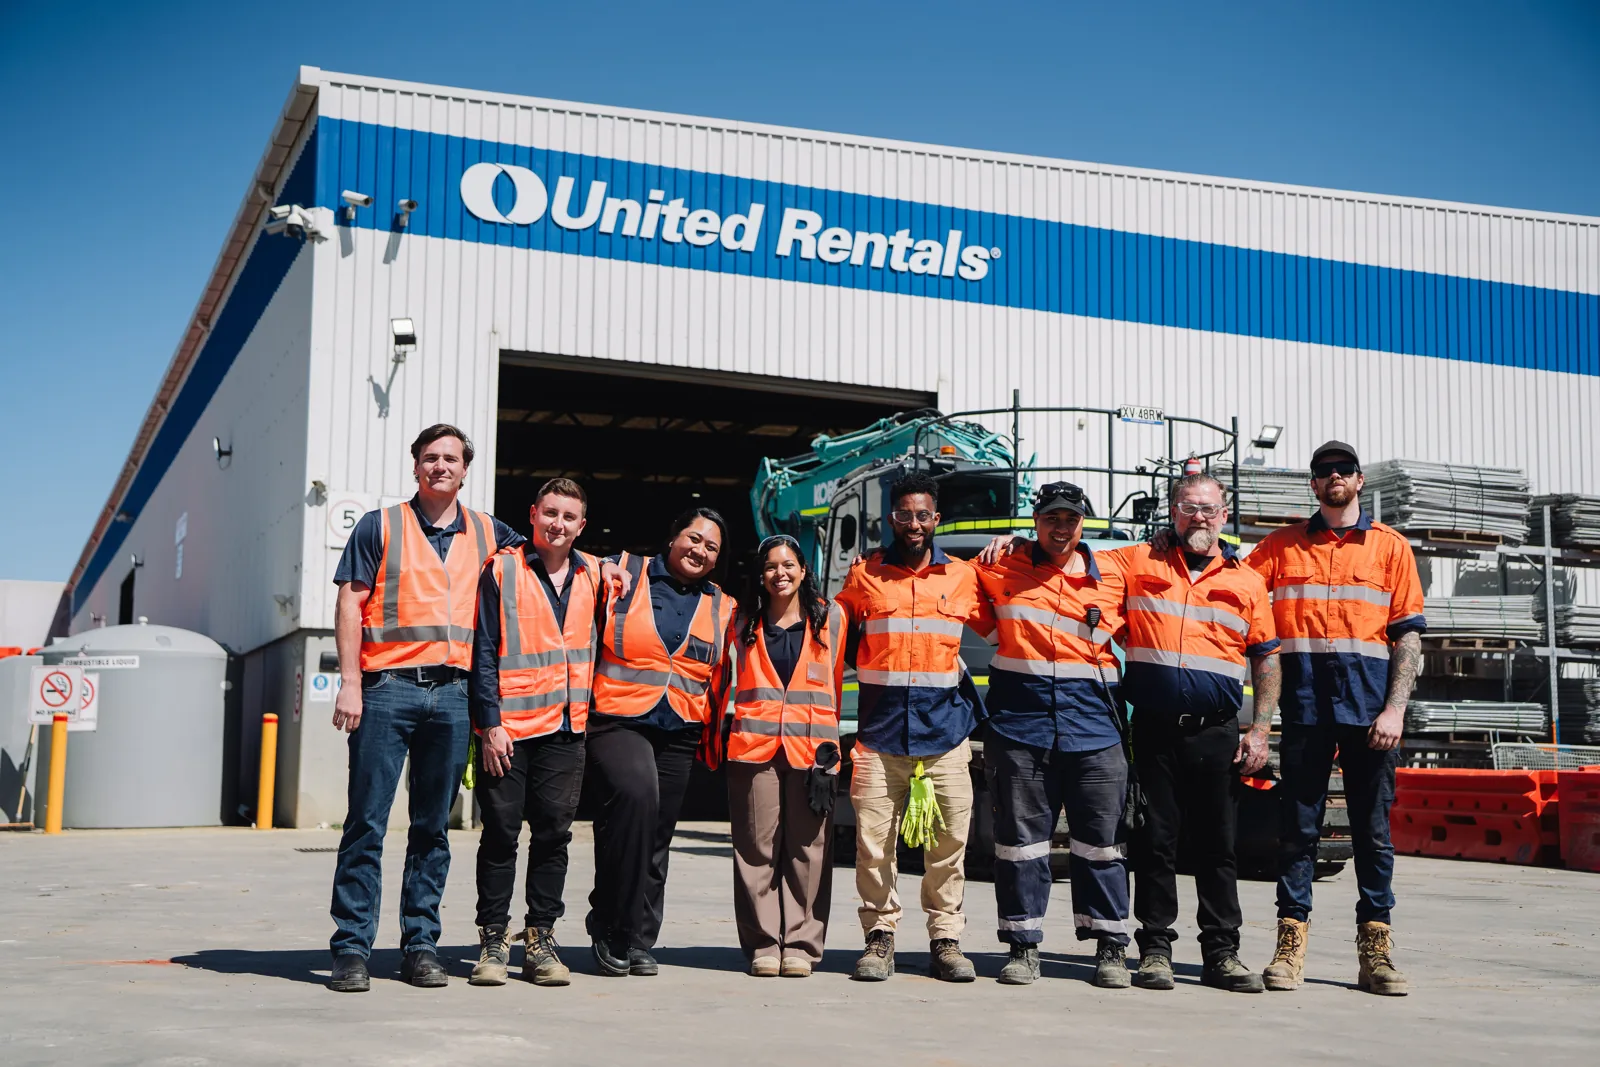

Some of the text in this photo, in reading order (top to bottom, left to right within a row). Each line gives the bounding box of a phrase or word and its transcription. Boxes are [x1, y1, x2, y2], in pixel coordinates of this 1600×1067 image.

[551, 175, 765, 253] United
[343, 510, 356, 529] 5
[65, 658, 137, 667] COMBUSTIBLE LIQUID
